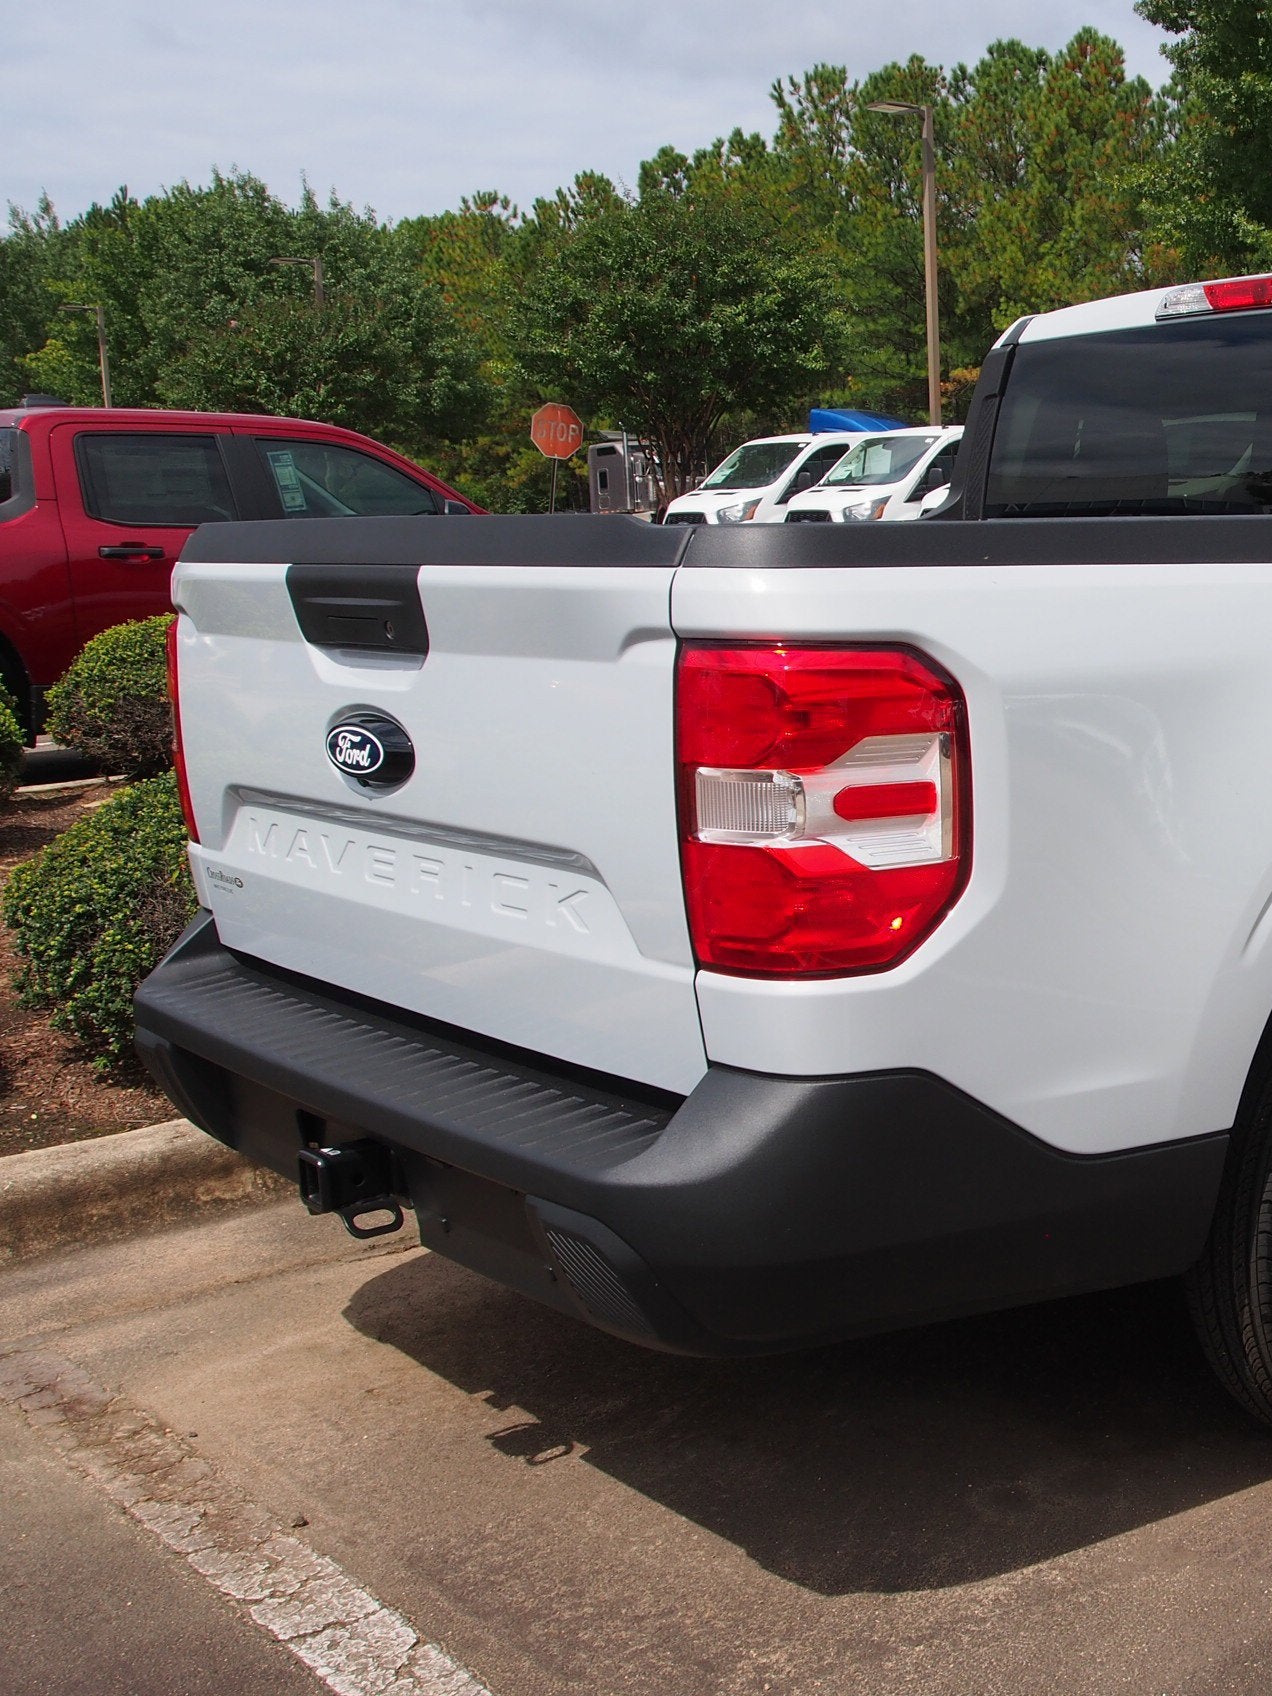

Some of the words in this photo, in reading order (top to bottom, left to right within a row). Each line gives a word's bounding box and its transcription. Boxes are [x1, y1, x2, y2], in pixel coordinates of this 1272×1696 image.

[537, 420, 579, 443] STOP
[336, 732, 370, 767] Ford
[248, 818, 591, 935] MAVERICK
